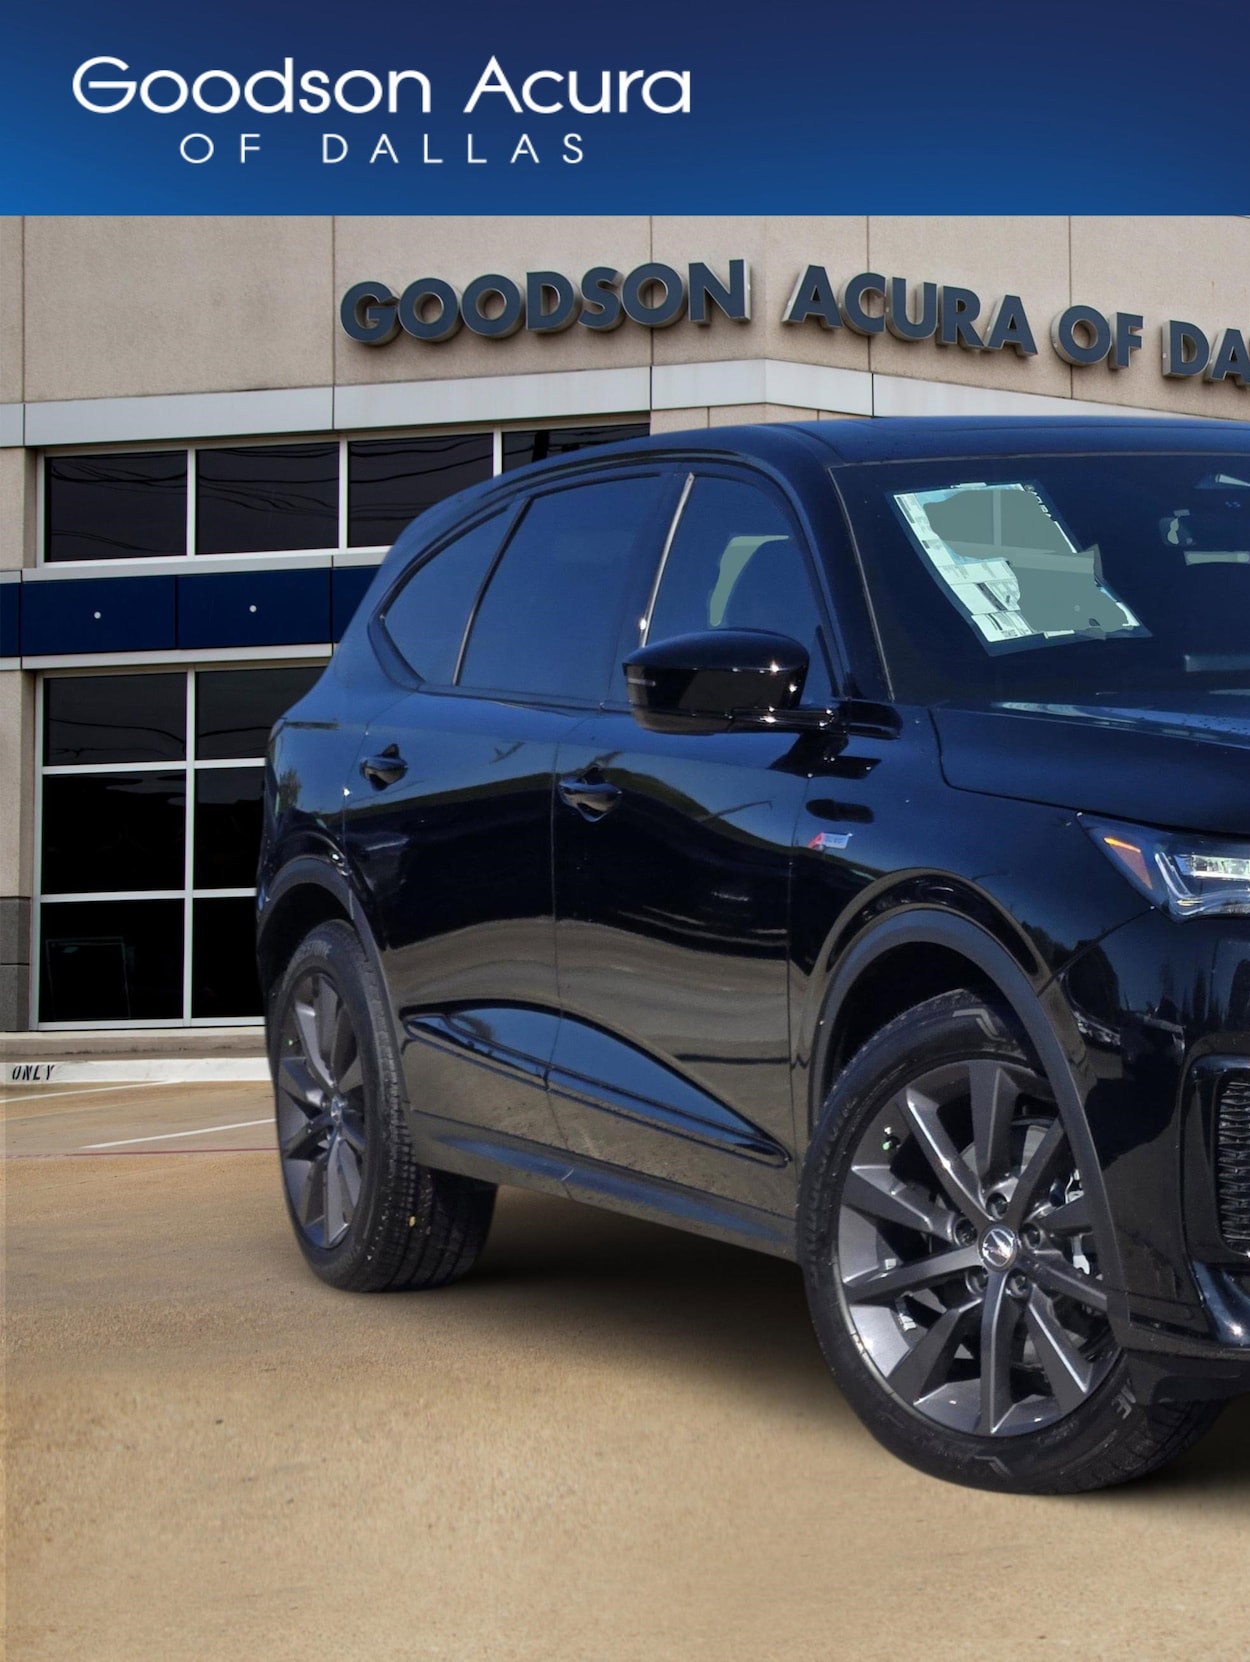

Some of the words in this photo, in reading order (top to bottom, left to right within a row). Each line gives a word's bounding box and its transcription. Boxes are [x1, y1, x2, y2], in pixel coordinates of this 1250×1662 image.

[340, 258, 751, 346] GOODSON
[782, 265, 1038, 356] ACURA
[1051, 305, 1143, 370] OF
[12, 1064, 55, 1081] ONLY
